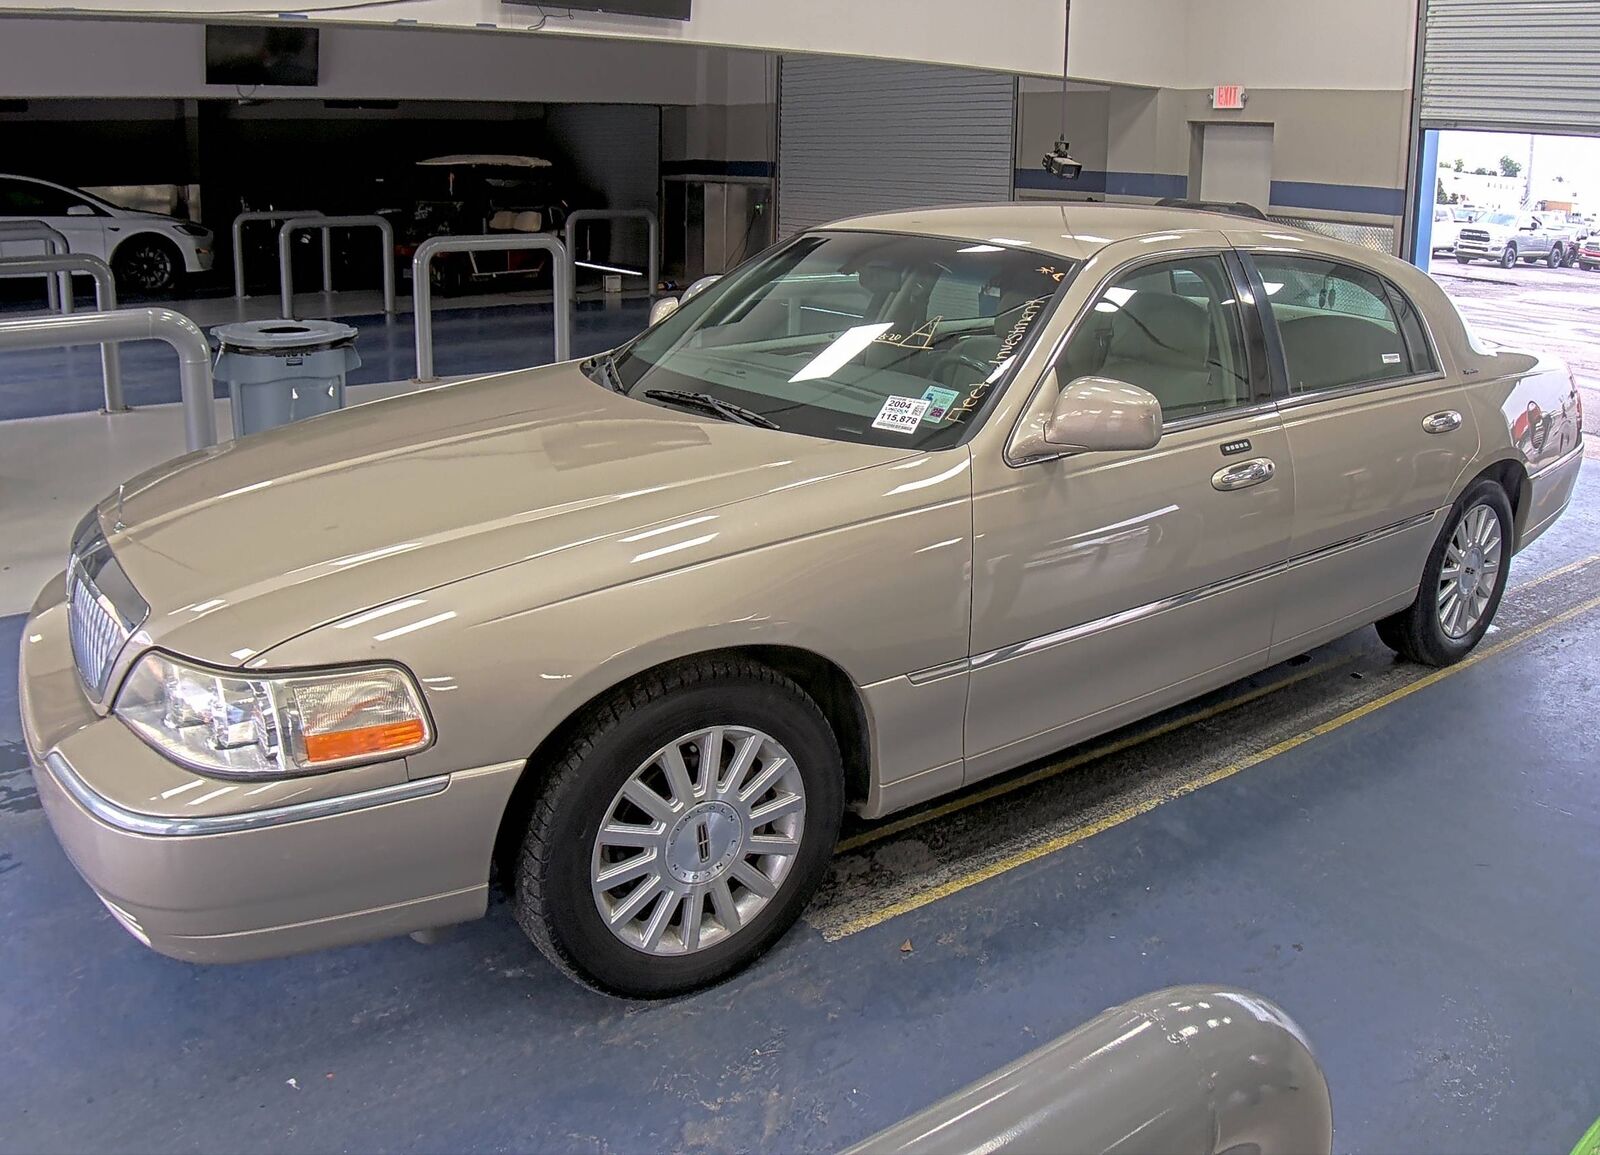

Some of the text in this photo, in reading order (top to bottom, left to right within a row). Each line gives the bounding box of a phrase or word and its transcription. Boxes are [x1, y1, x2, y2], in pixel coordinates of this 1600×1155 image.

[1218, 86, 1239, 106] EXIT
[888, 400, 912, 409] 2004
[884, 406, 910, 414] LINCOLN
[932, 408, 942, 417] 25
[880, 412, 918, 425] 115,878
